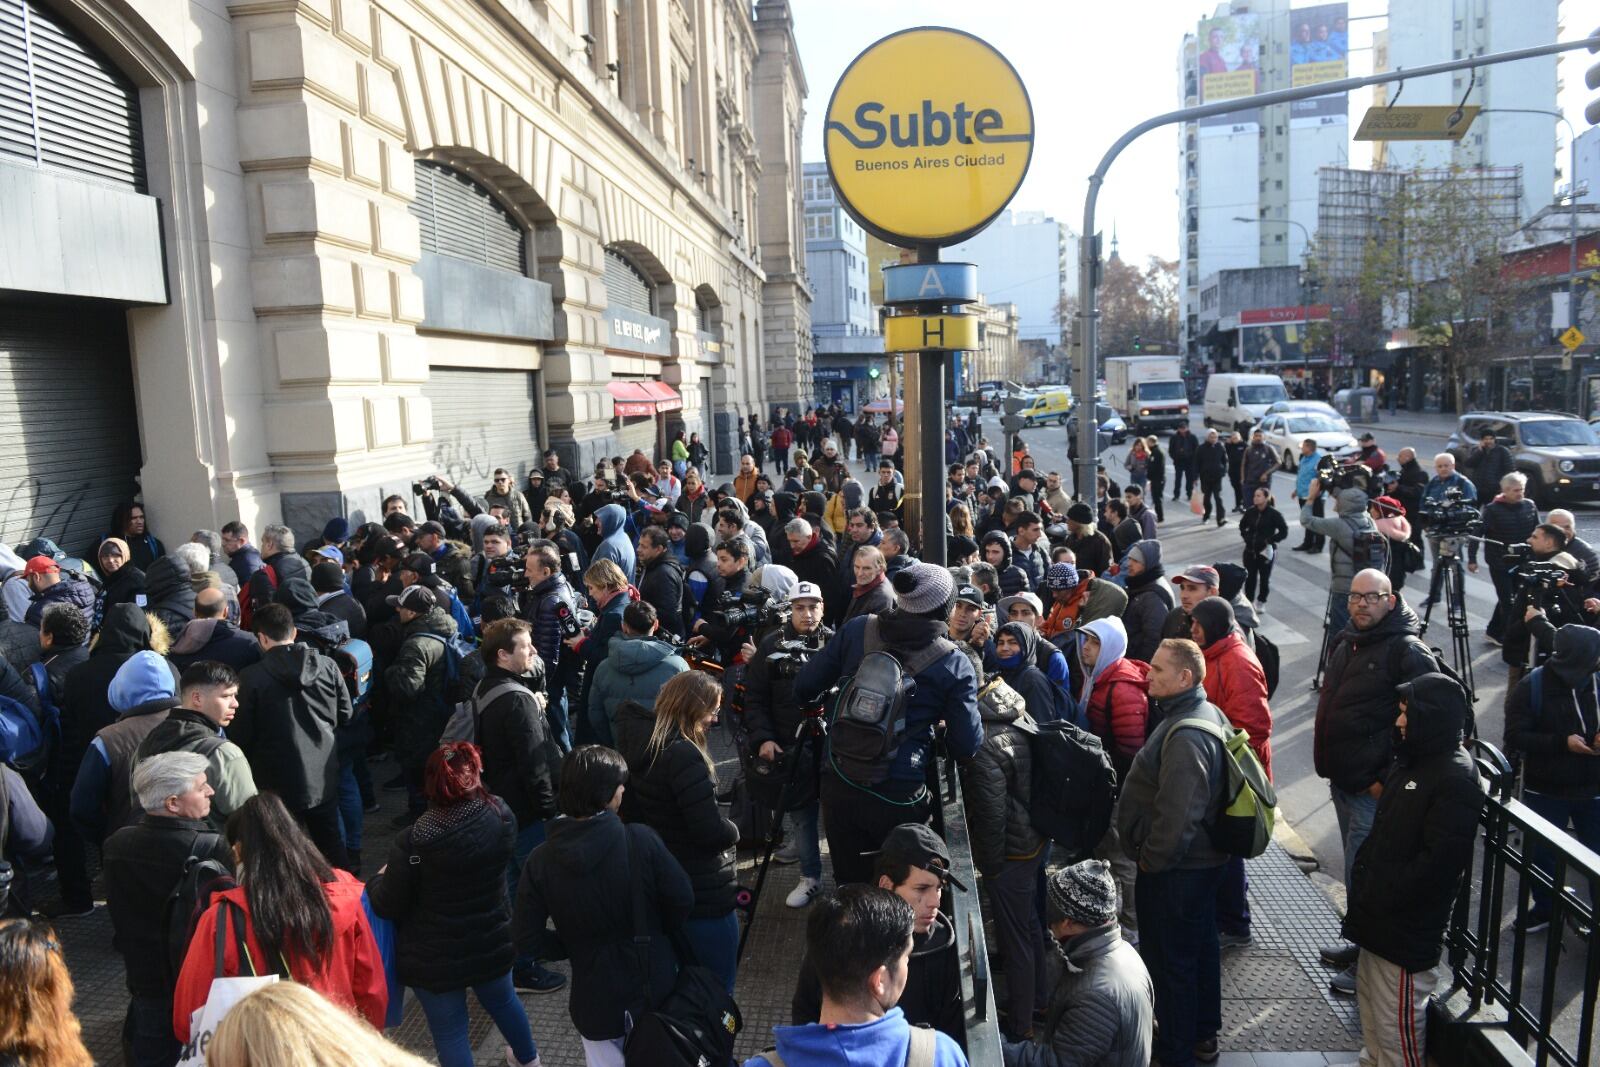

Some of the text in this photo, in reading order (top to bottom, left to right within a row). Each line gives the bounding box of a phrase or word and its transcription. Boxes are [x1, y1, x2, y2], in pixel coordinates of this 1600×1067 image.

[855, 100, 1003, 149] Subte
[855, 153, 1005, 172] Buenos Aires Ciudad
[919, 267, 945, 297] A
[614, 318, 622, 335] EL
[923, 319, 944, 347] H
